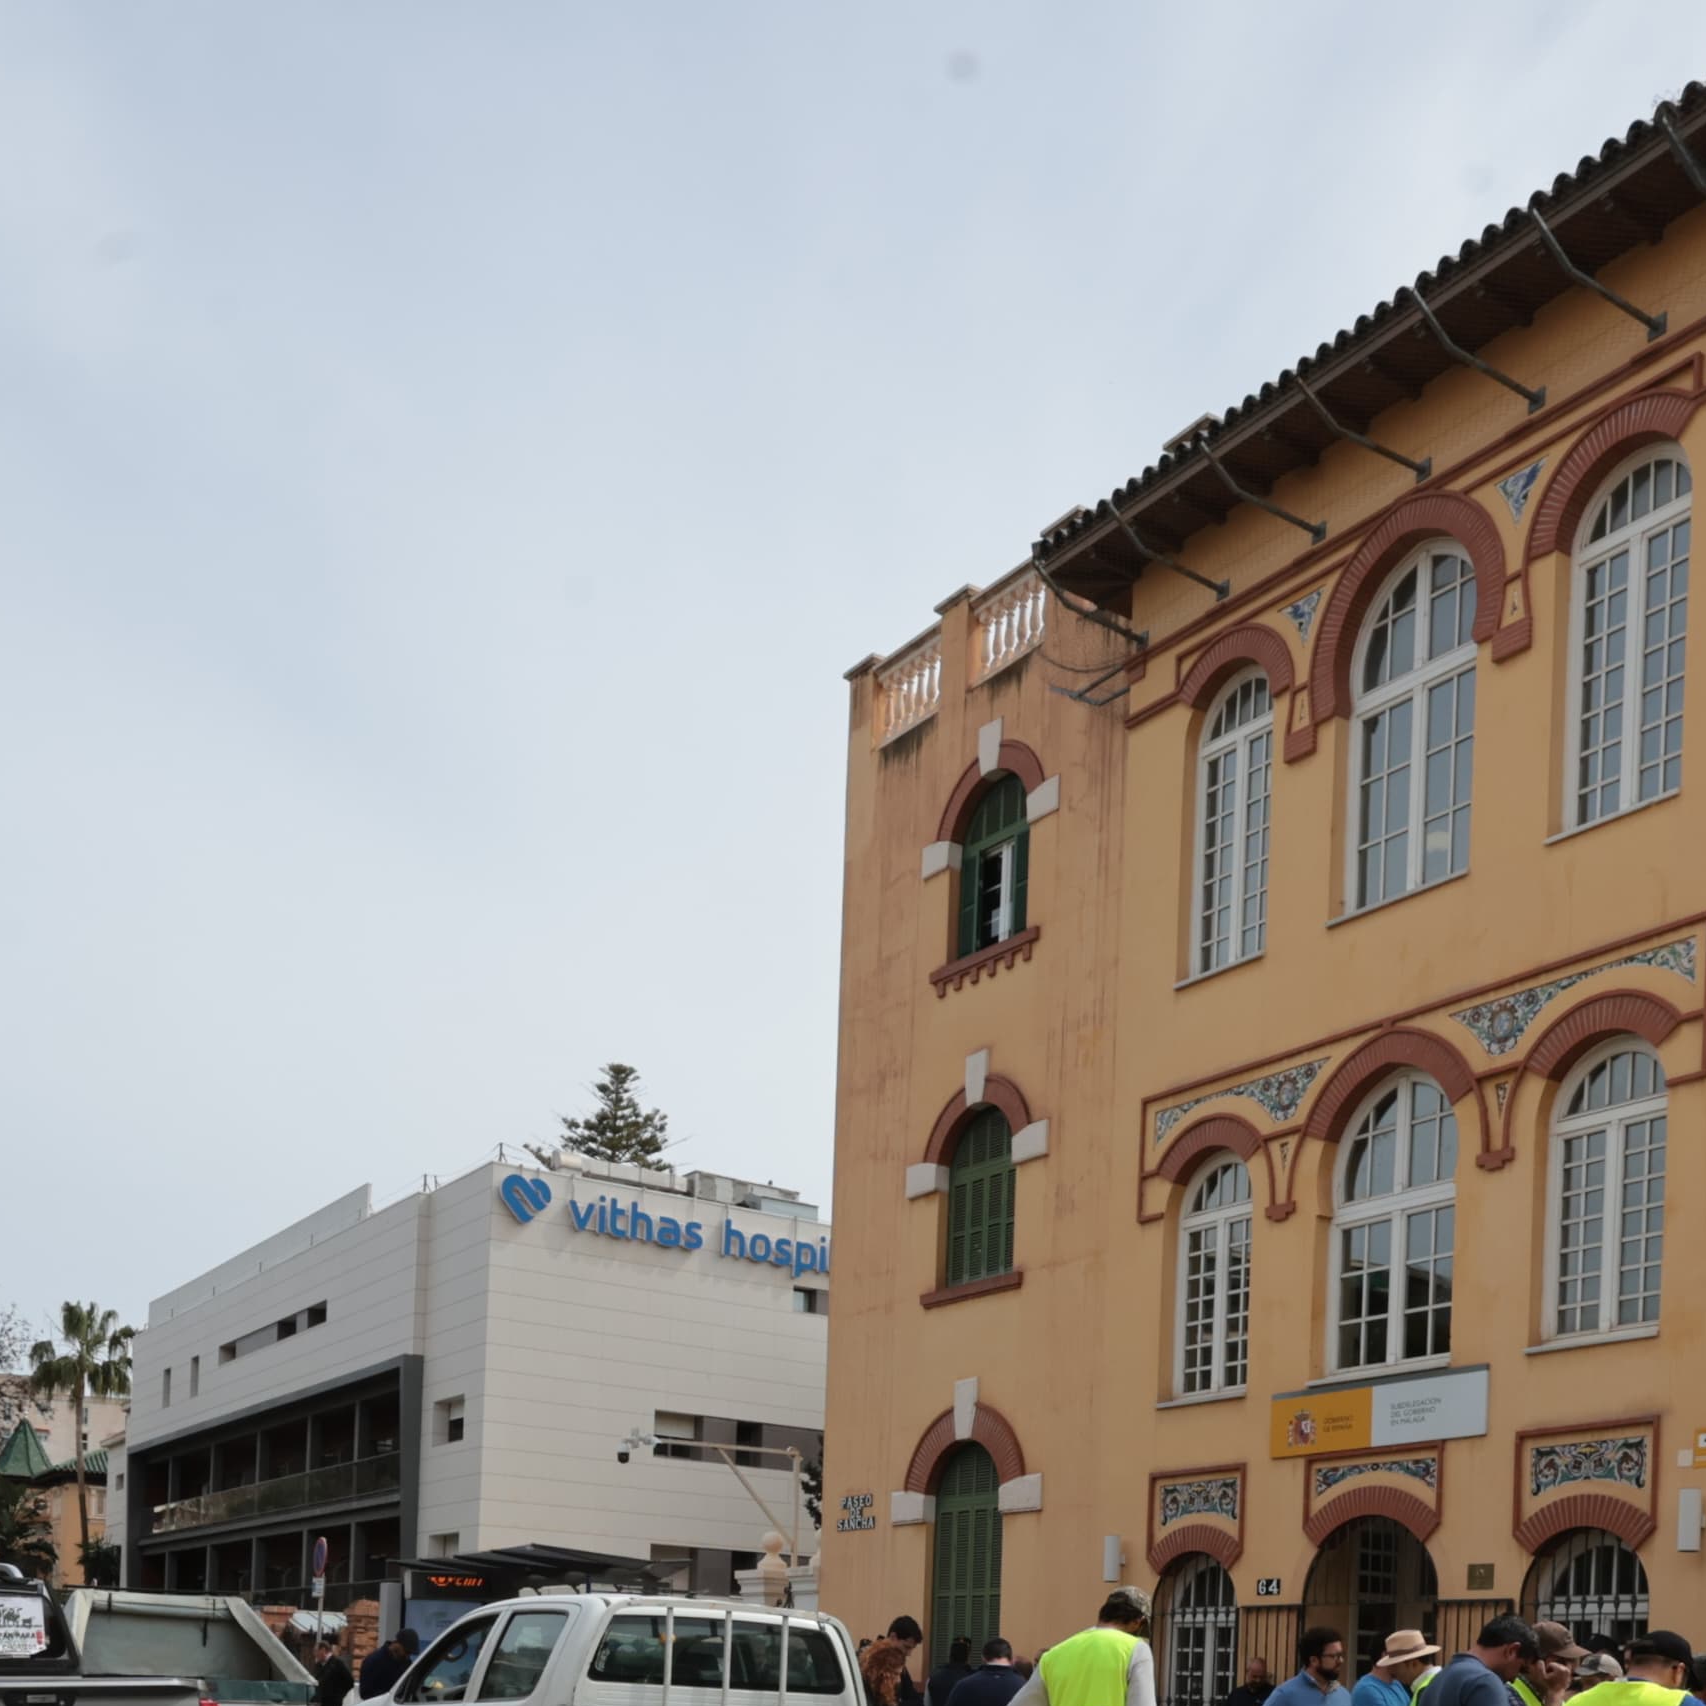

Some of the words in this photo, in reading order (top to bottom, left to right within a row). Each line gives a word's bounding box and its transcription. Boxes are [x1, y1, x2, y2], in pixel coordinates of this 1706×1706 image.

[570, 1195, 704, 1250] vithas
[841, 1494, 872, 1508] PASEO
[850, 1507, 862, 1519] DE
[837, 1516, 874, 1532] SANCHA
[1258, 1579, 1280, 1595] 64
